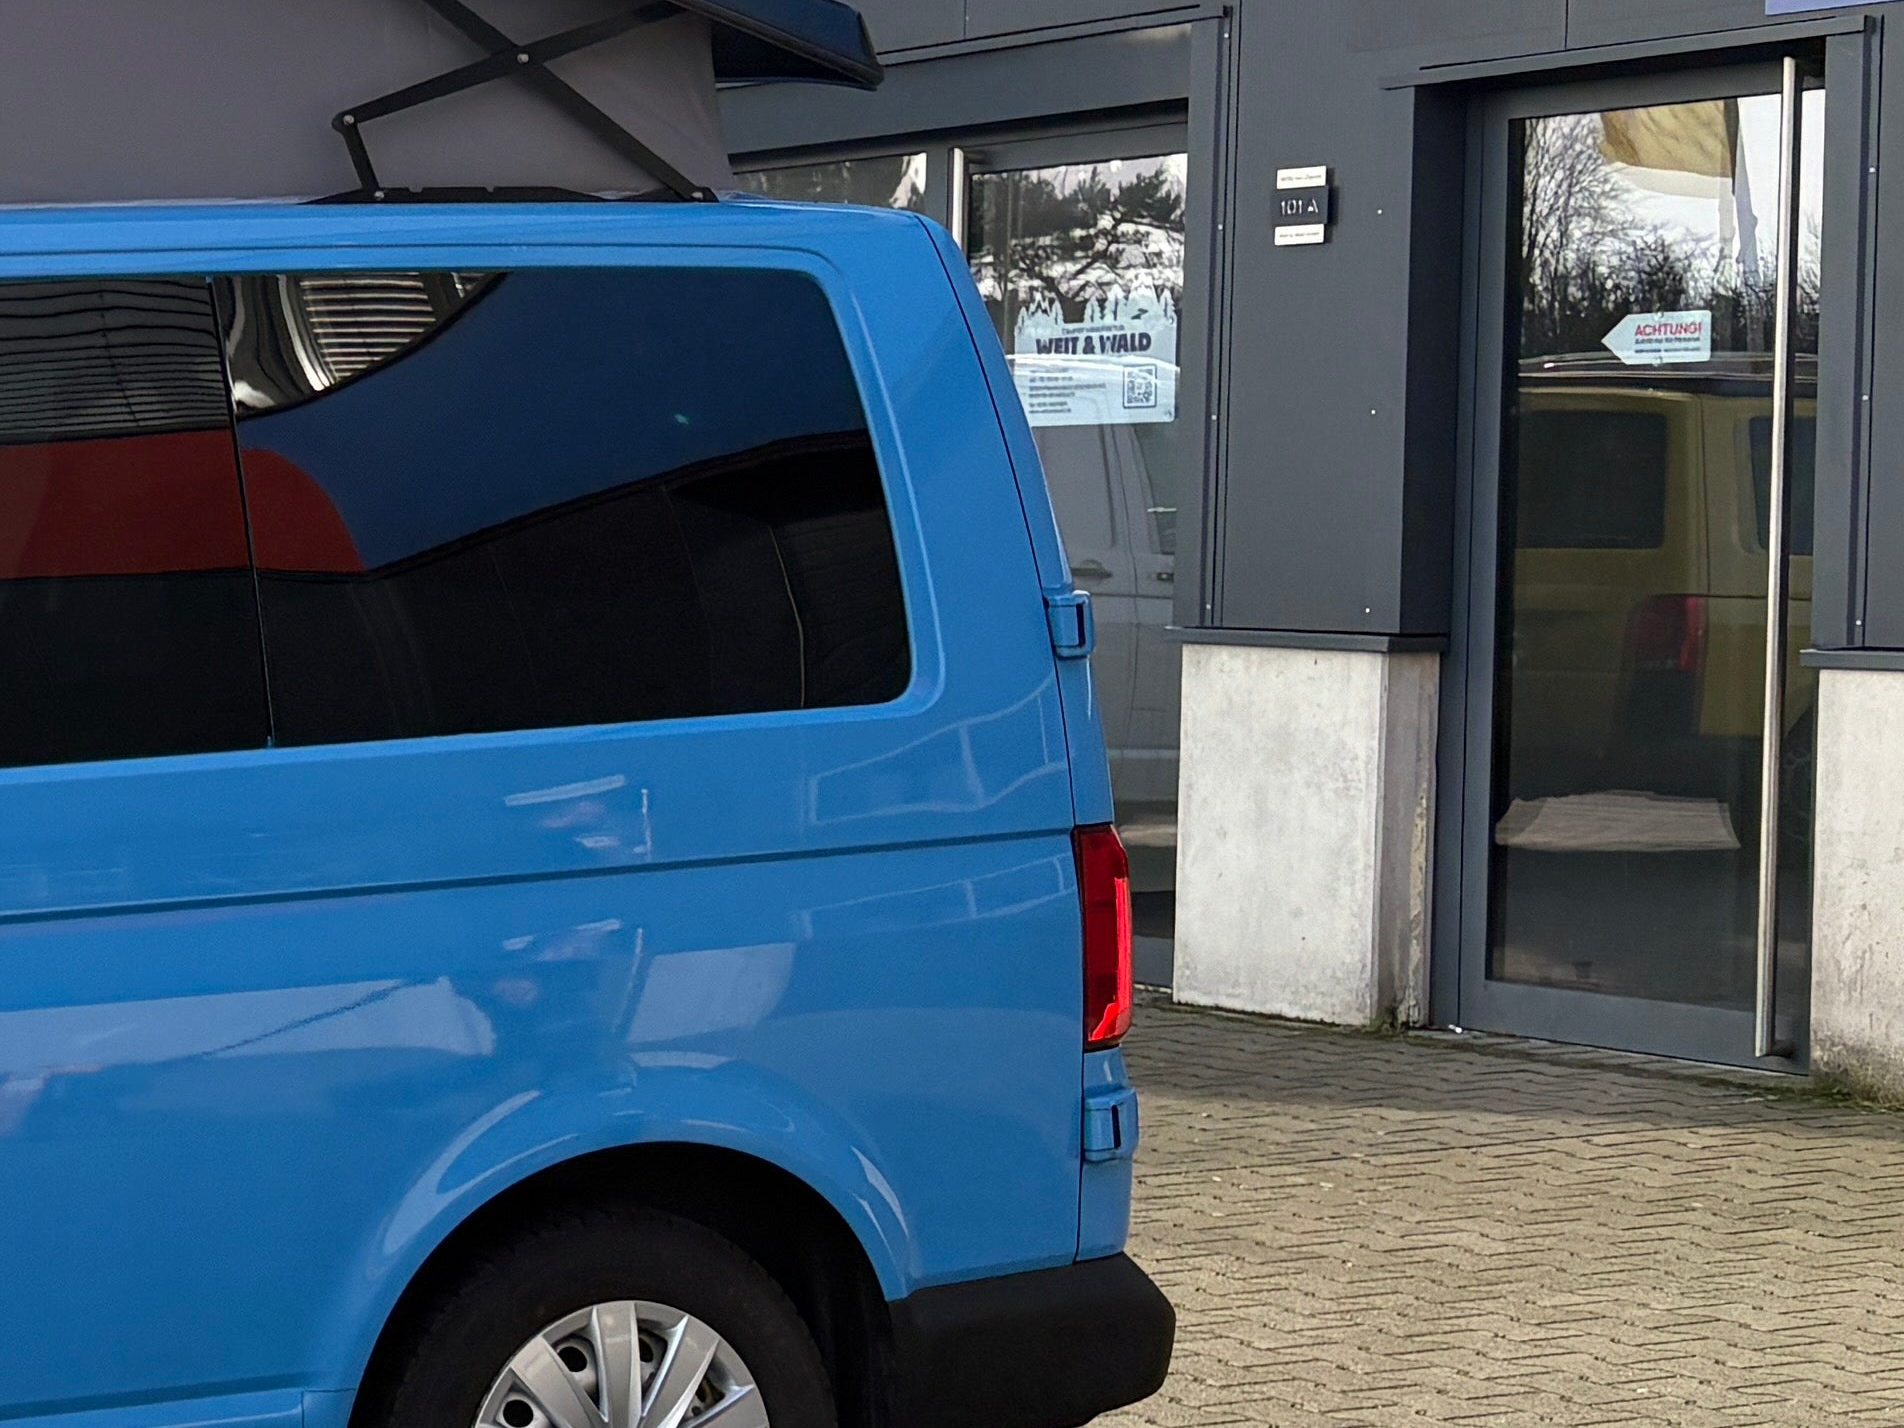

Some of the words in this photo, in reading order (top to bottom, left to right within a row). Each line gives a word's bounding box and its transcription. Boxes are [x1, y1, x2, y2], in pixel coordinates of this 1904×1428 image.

[1280, 199, 1303, 215] 101
[1036, 335, 1080, 355] WEIT
[1082, 335, 1096, 355] &
[1099, 332, 1152, 354] WALD
